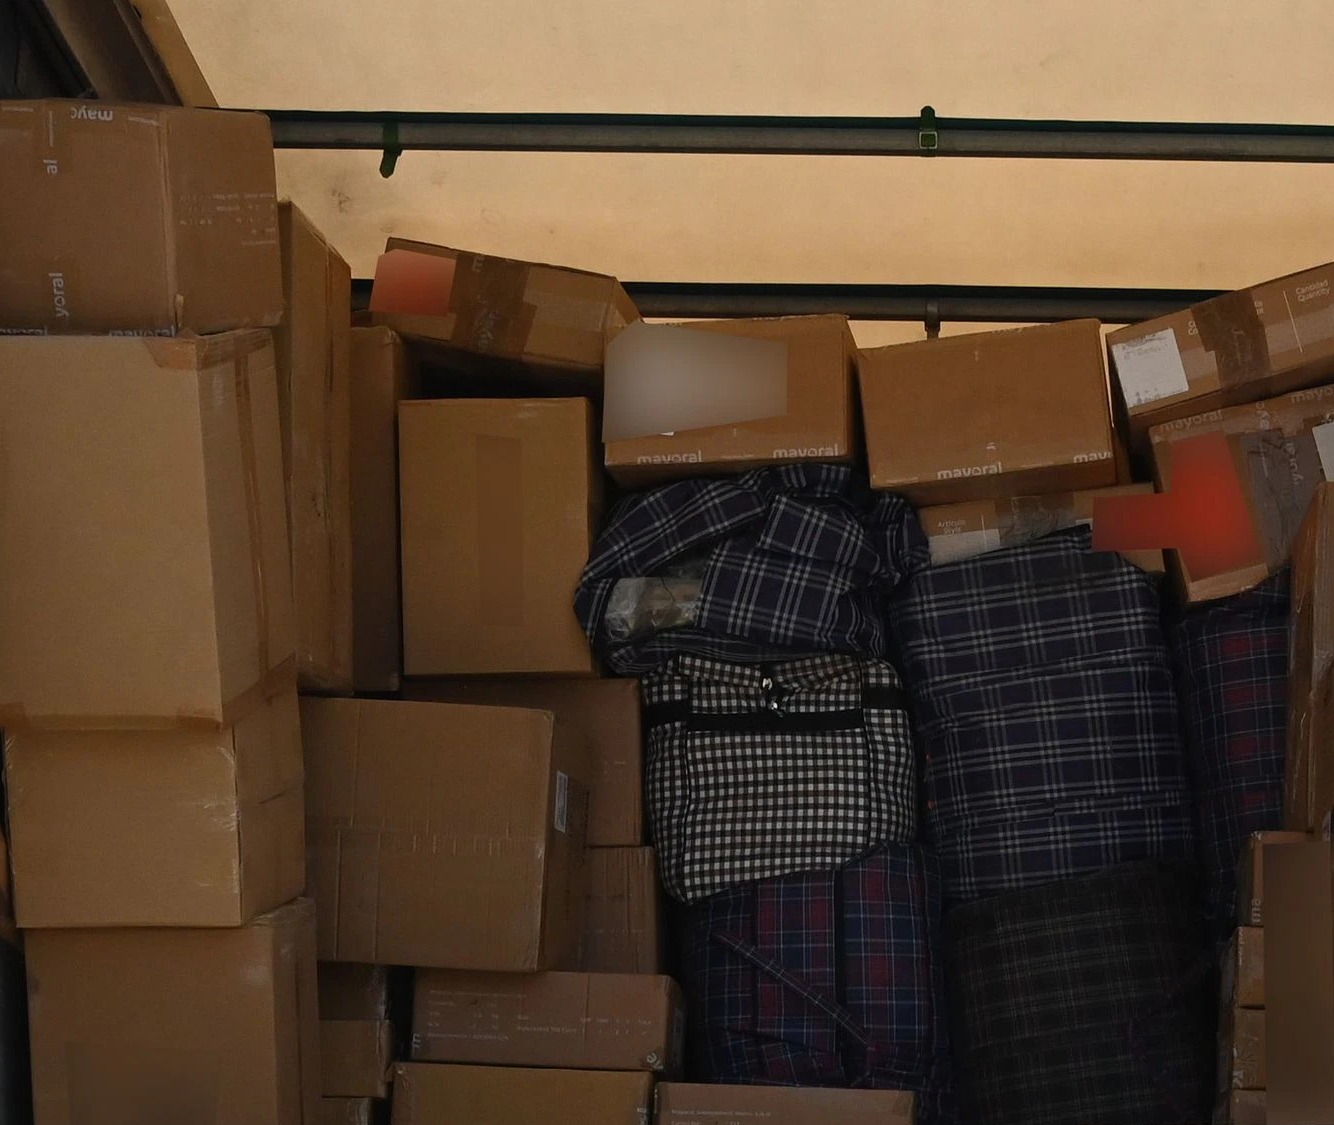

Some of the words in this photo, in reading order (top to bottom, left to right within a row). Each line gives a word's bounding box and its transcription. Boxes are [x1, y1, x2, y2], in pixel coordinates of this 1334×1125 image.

[637, 450, 703, 465] mayoral
[773, 444, 839, 459] mayoral
[937, 461, 1002, 480] mayoral
